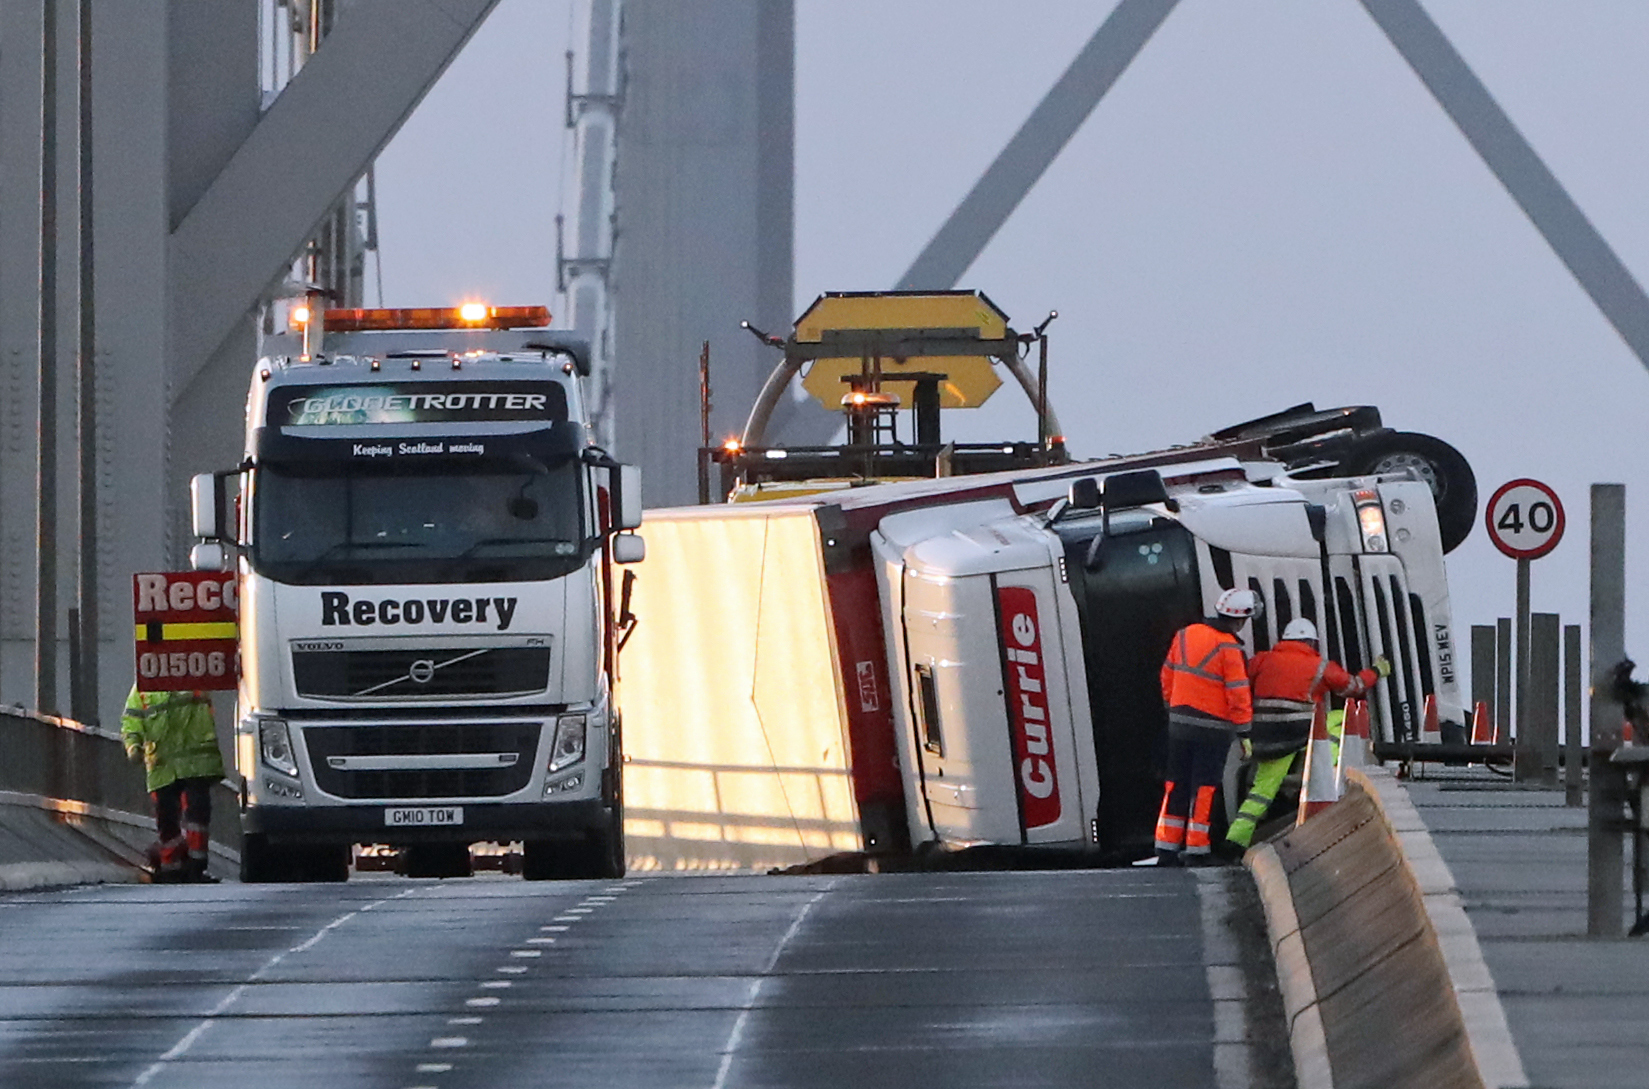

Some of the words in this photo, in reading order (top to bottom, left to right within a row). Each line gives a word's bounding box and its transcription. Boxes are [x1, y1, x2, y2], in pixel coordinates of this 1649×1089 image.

[353, 444, 393, 457] Keeping
[398, 442, 444, 455] Scotland
[449, 443, 484, 456] moving
[1497, 501, 1555, 534] 40
[320, 591, 518, 631] Recovery
[296, 642, 344, 651] VOLVO
[139, 651, 226, 678] 01506
[1006, 613, 1054, 799] Currie
[393, 810, 424, 823] GM10
[428, 809, 455, 823] TOW
